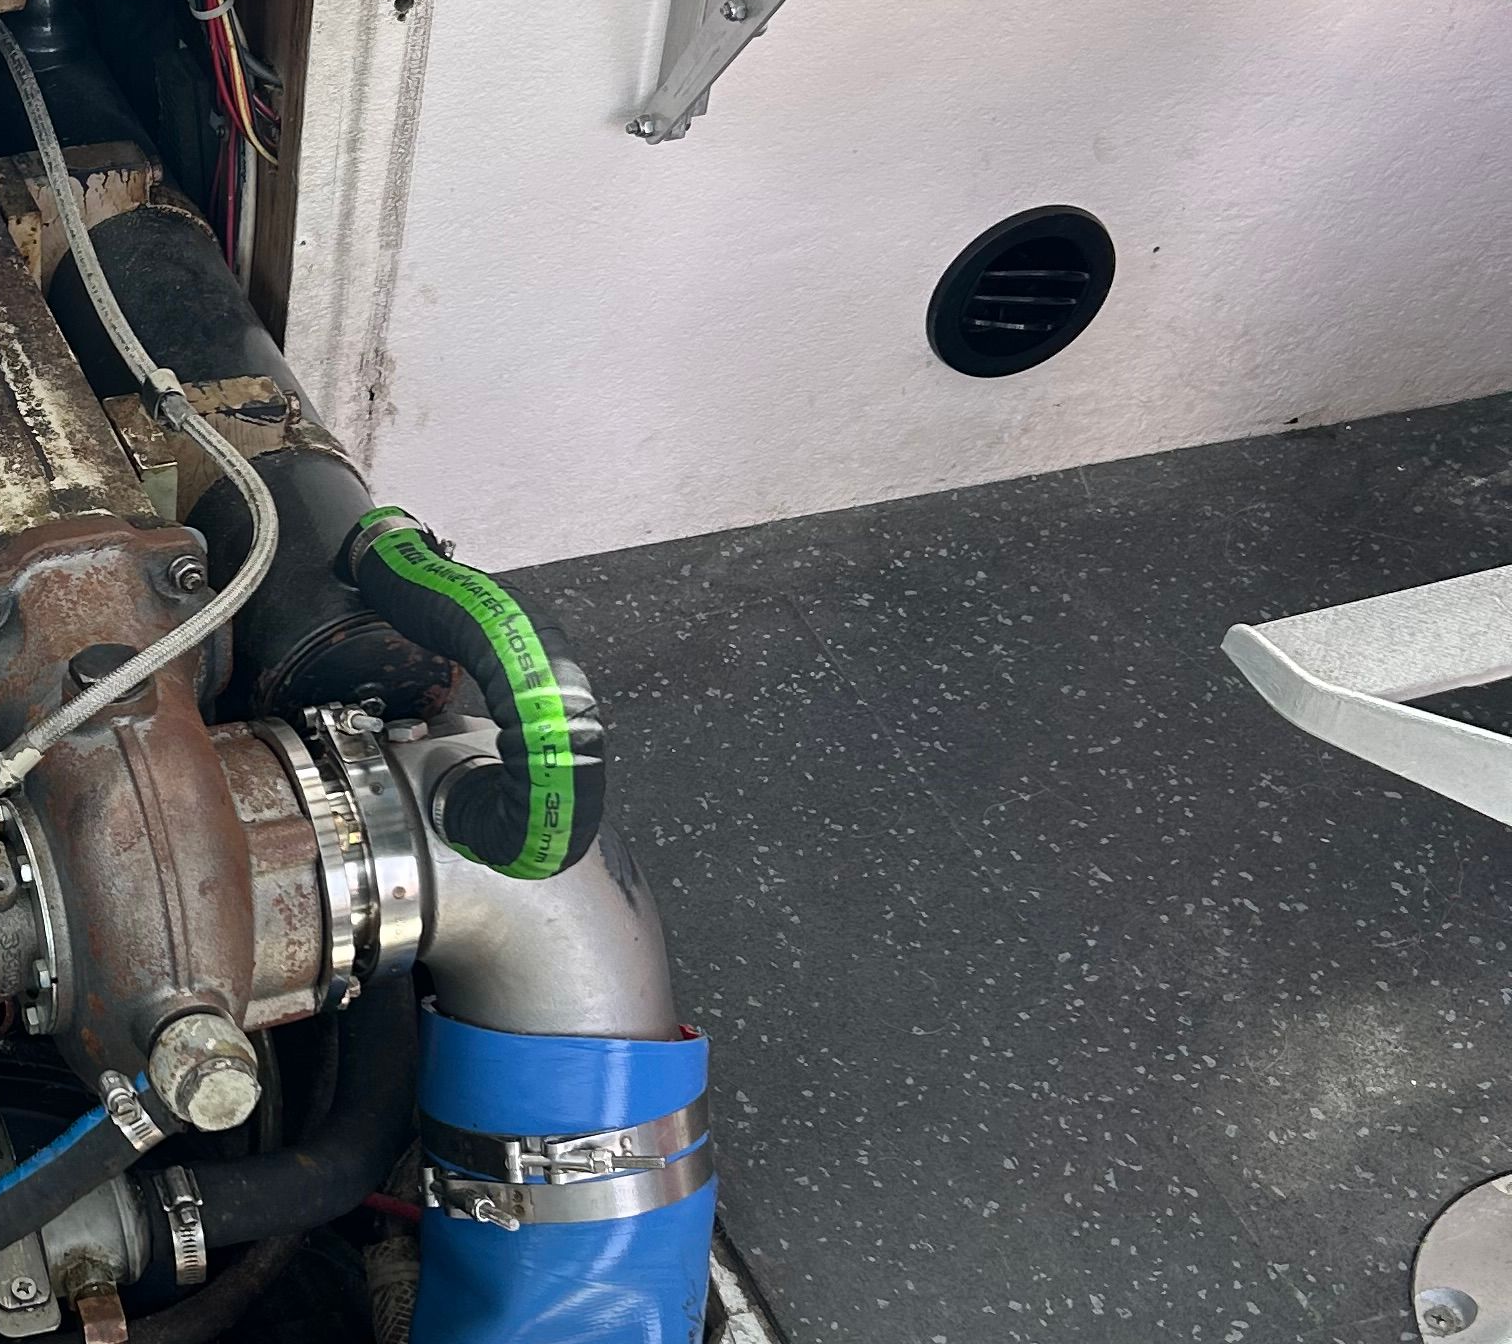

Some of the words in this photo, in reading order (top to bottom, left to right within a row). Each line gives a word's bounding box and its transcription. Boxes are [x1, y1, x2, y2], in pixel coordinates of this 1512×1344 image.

[460, 571, 506, 618] WATER
[499, 616, 543, 690] HOSE
[544, 791, 560, 829] 32
[534, 832, 553, 864] mm
